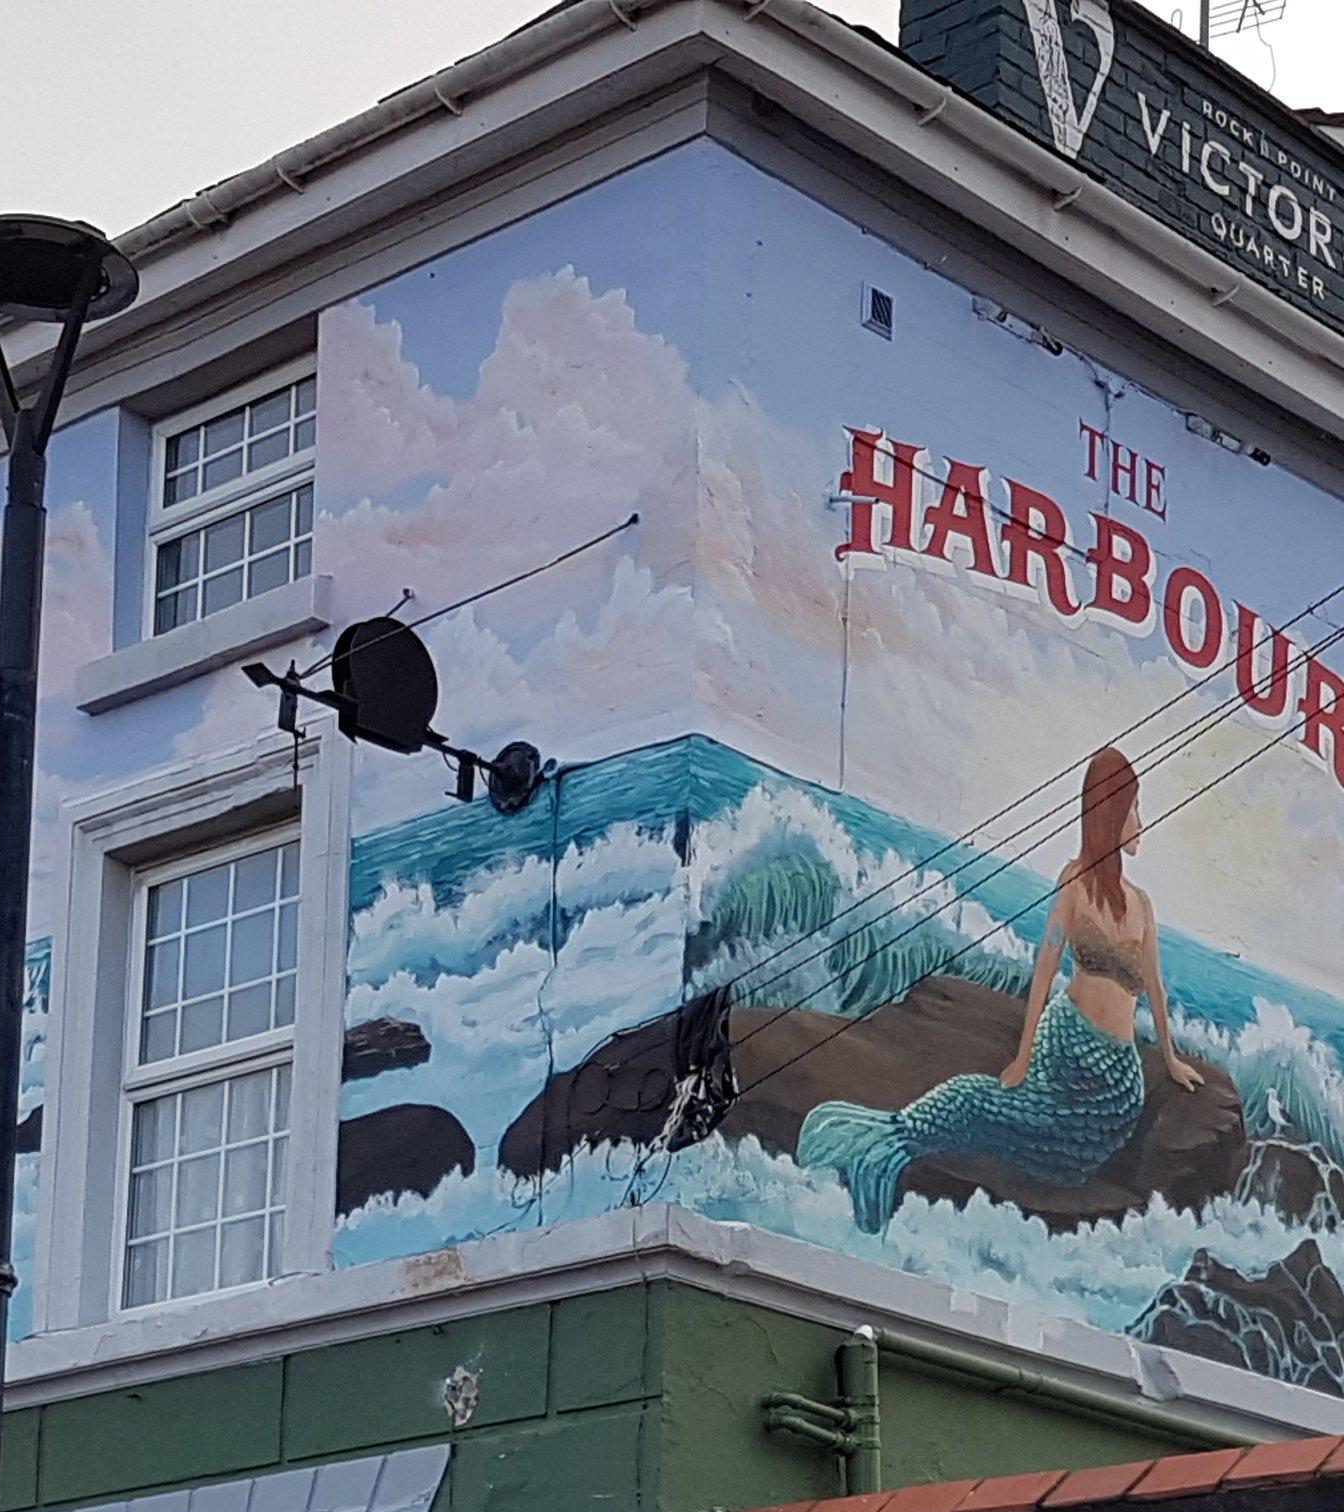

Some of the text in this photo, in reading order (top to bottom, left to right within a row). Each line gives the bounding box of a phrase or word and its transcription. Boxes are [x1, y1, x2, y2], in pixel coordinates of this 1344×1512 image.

[1202, 100, 1337, 201] ROCK POINT
[1211, 213, 1326, 299] QUARTER
[1078, 418, 1168, 522] THE
